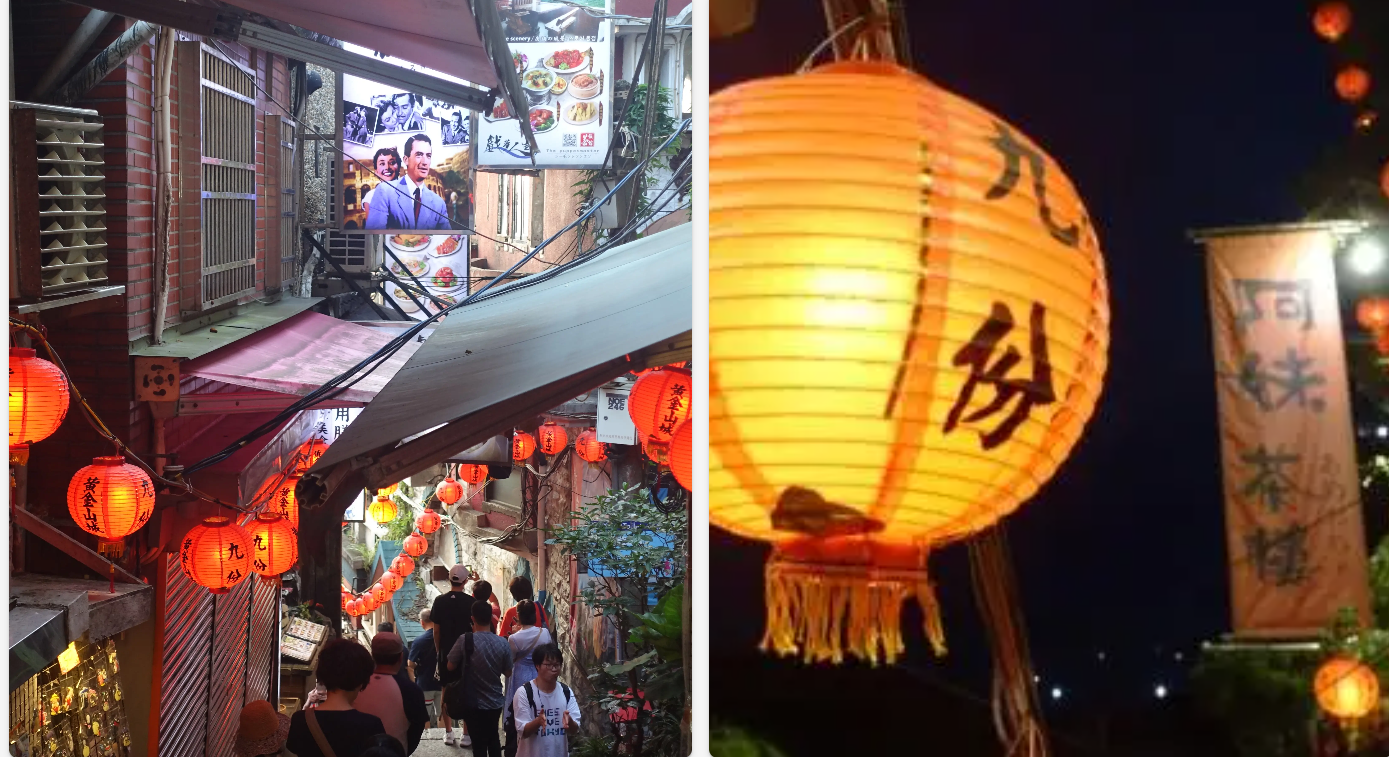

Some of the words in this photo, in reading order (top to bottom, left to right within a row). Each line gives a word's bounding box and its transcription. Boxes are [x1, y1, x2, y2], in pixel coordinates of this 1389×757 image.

[943, 120, 1080, 450] 九份
[82, 476, 105, 534] 黃金山城
[227, 542, 245, 585] 九份
[253, 534, 268, 572] 九份
